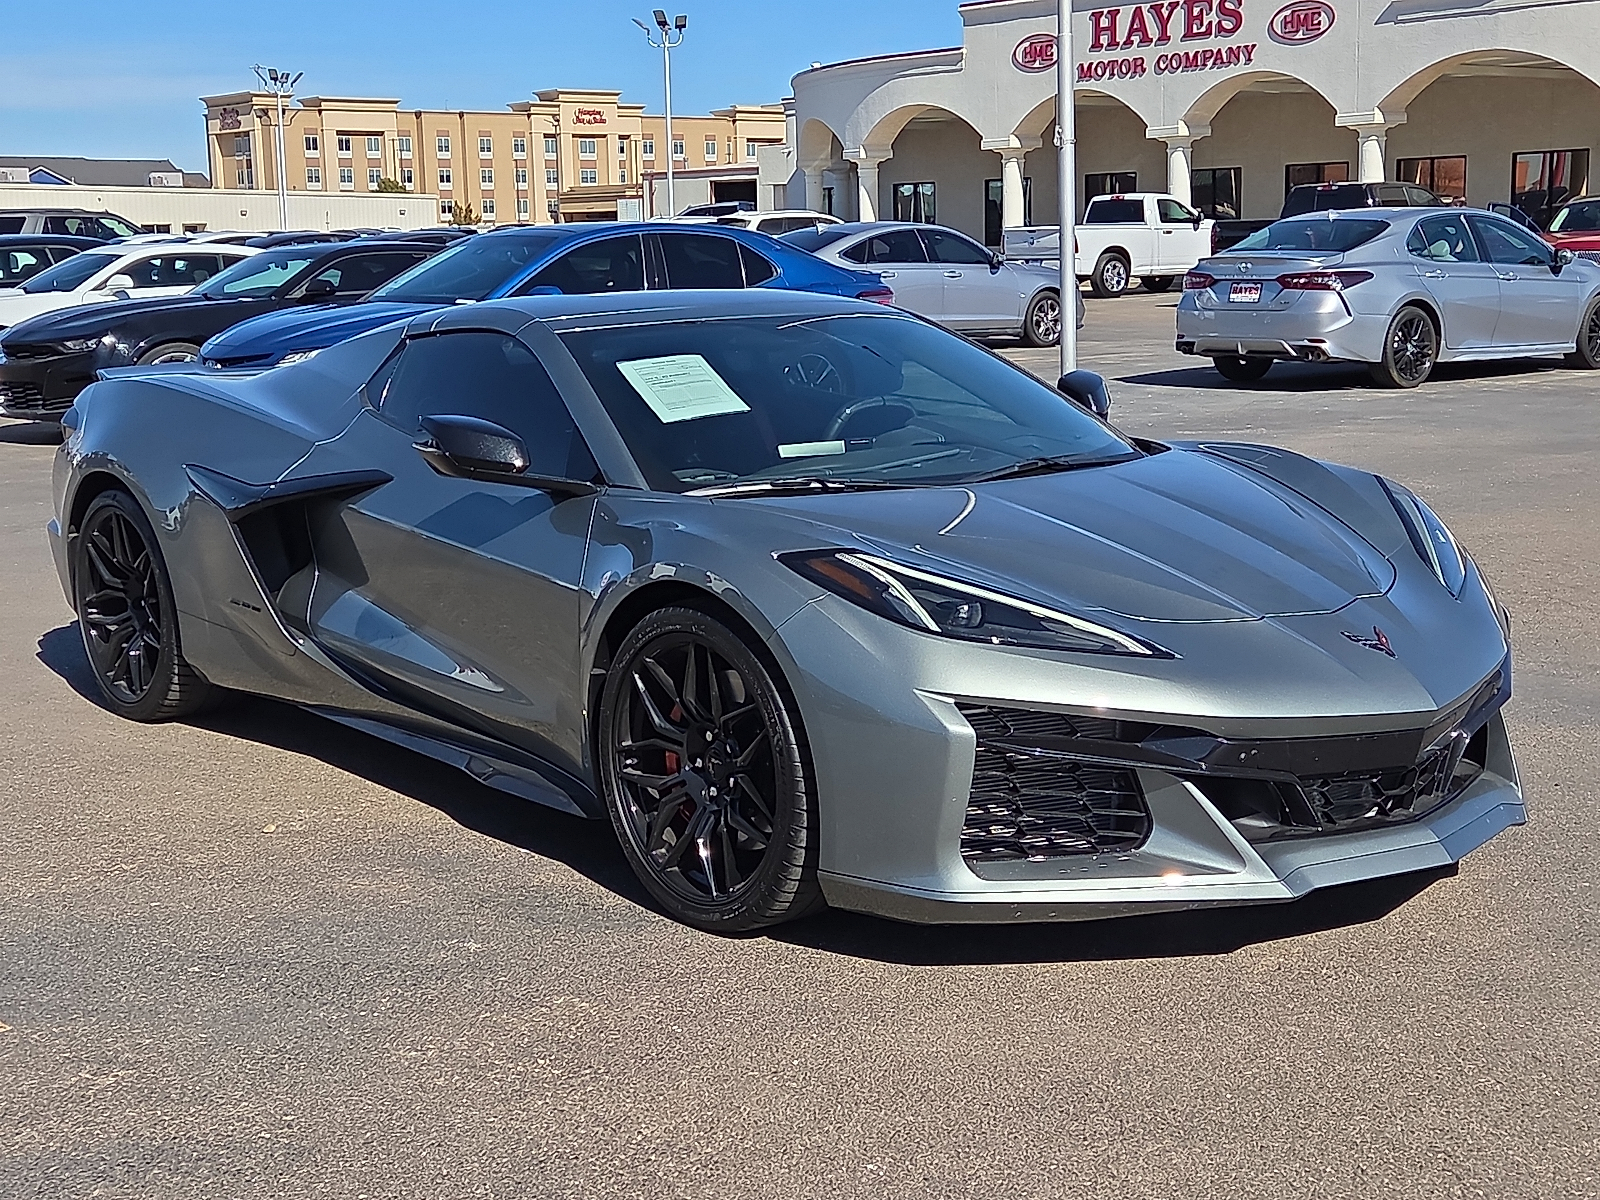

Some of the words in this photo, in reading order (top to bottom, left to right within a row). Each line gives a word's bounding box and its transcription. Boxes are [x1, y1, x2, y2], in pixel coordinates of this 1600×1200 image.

[1089, 0, 1243, 52] HAYES
[1076, 57, 1147, 83] MOTOR
[1154, 44, 1257, 76] COMPANY
[1231, 286, 1260, 295] HAYES
